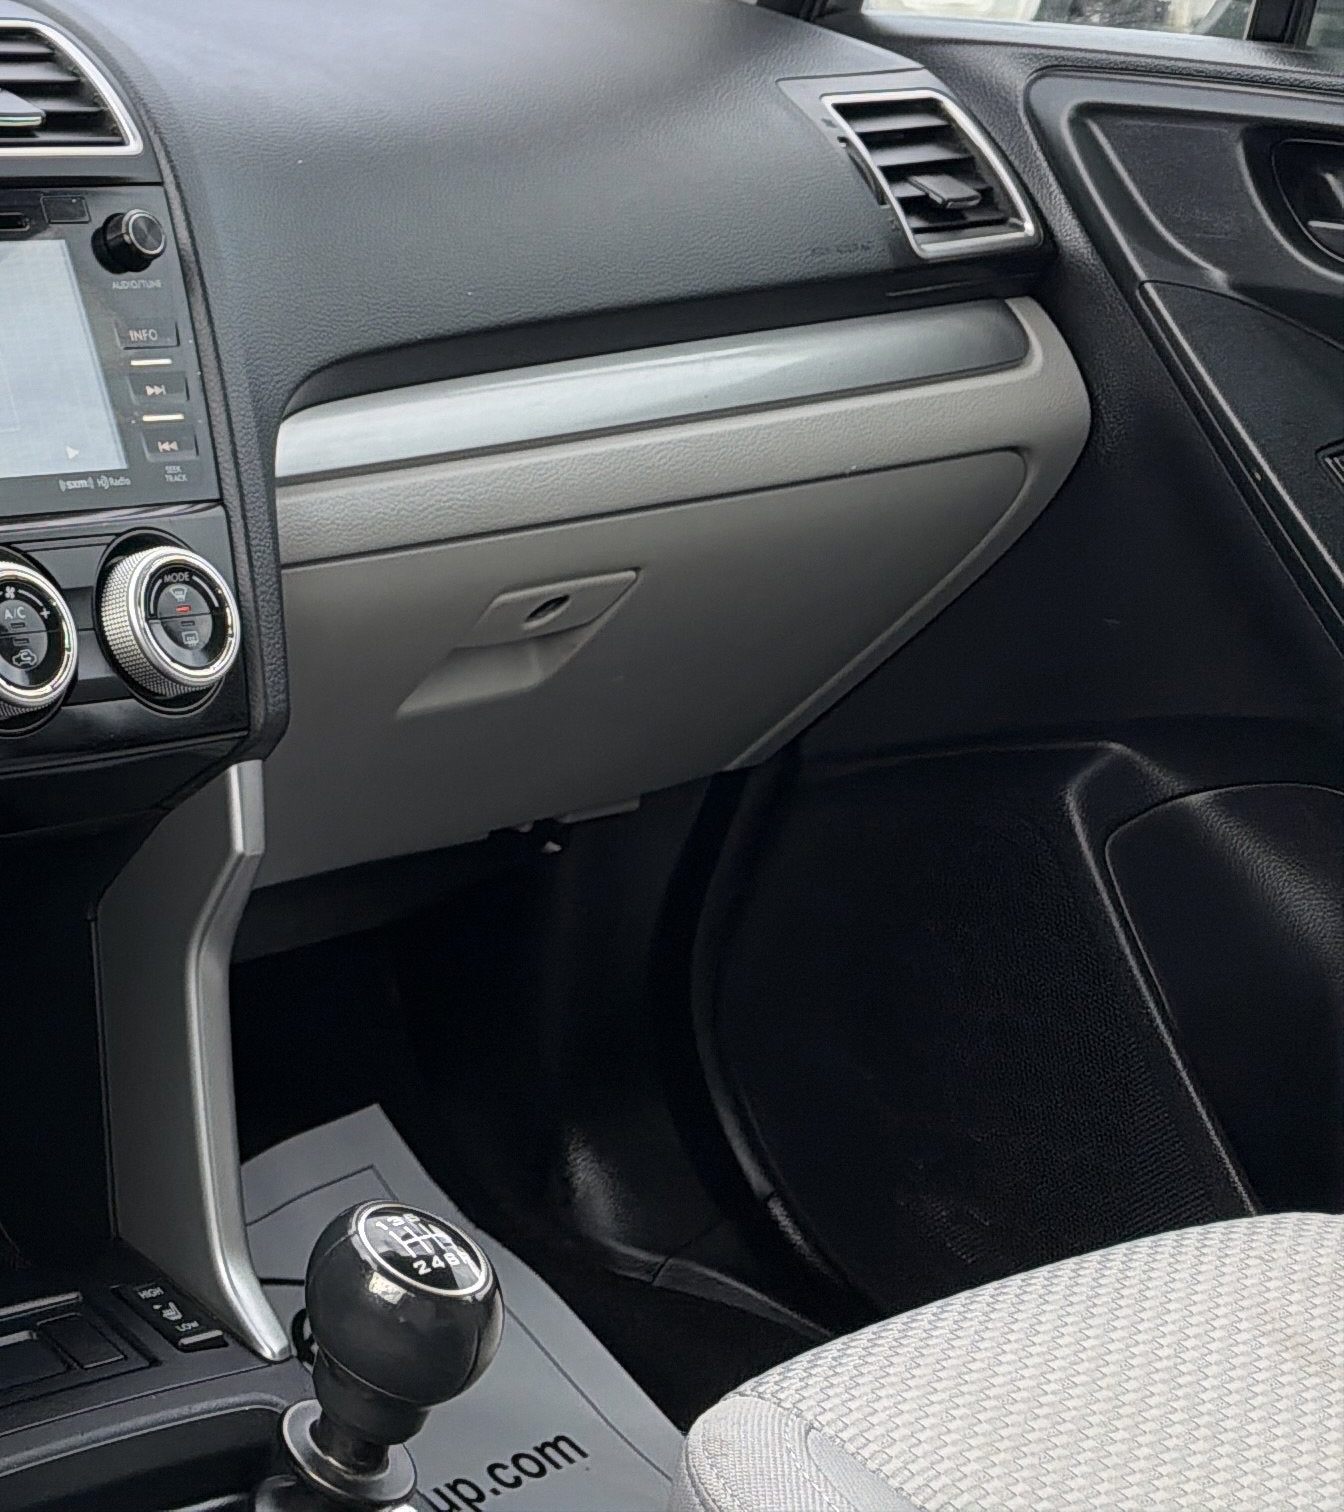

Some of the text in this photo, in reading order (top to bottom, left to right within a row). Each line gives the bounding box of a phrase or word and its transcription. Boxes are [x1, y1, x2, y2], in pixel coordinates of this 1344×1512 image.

[129, 329, 159, 342] INFO
[163, 572, 190, 584] MODE
[4, 605, 26, 621] A/C
[137, 1287, 164, 1300] HIGH
[176, 1320, 200, 1333] LOW
